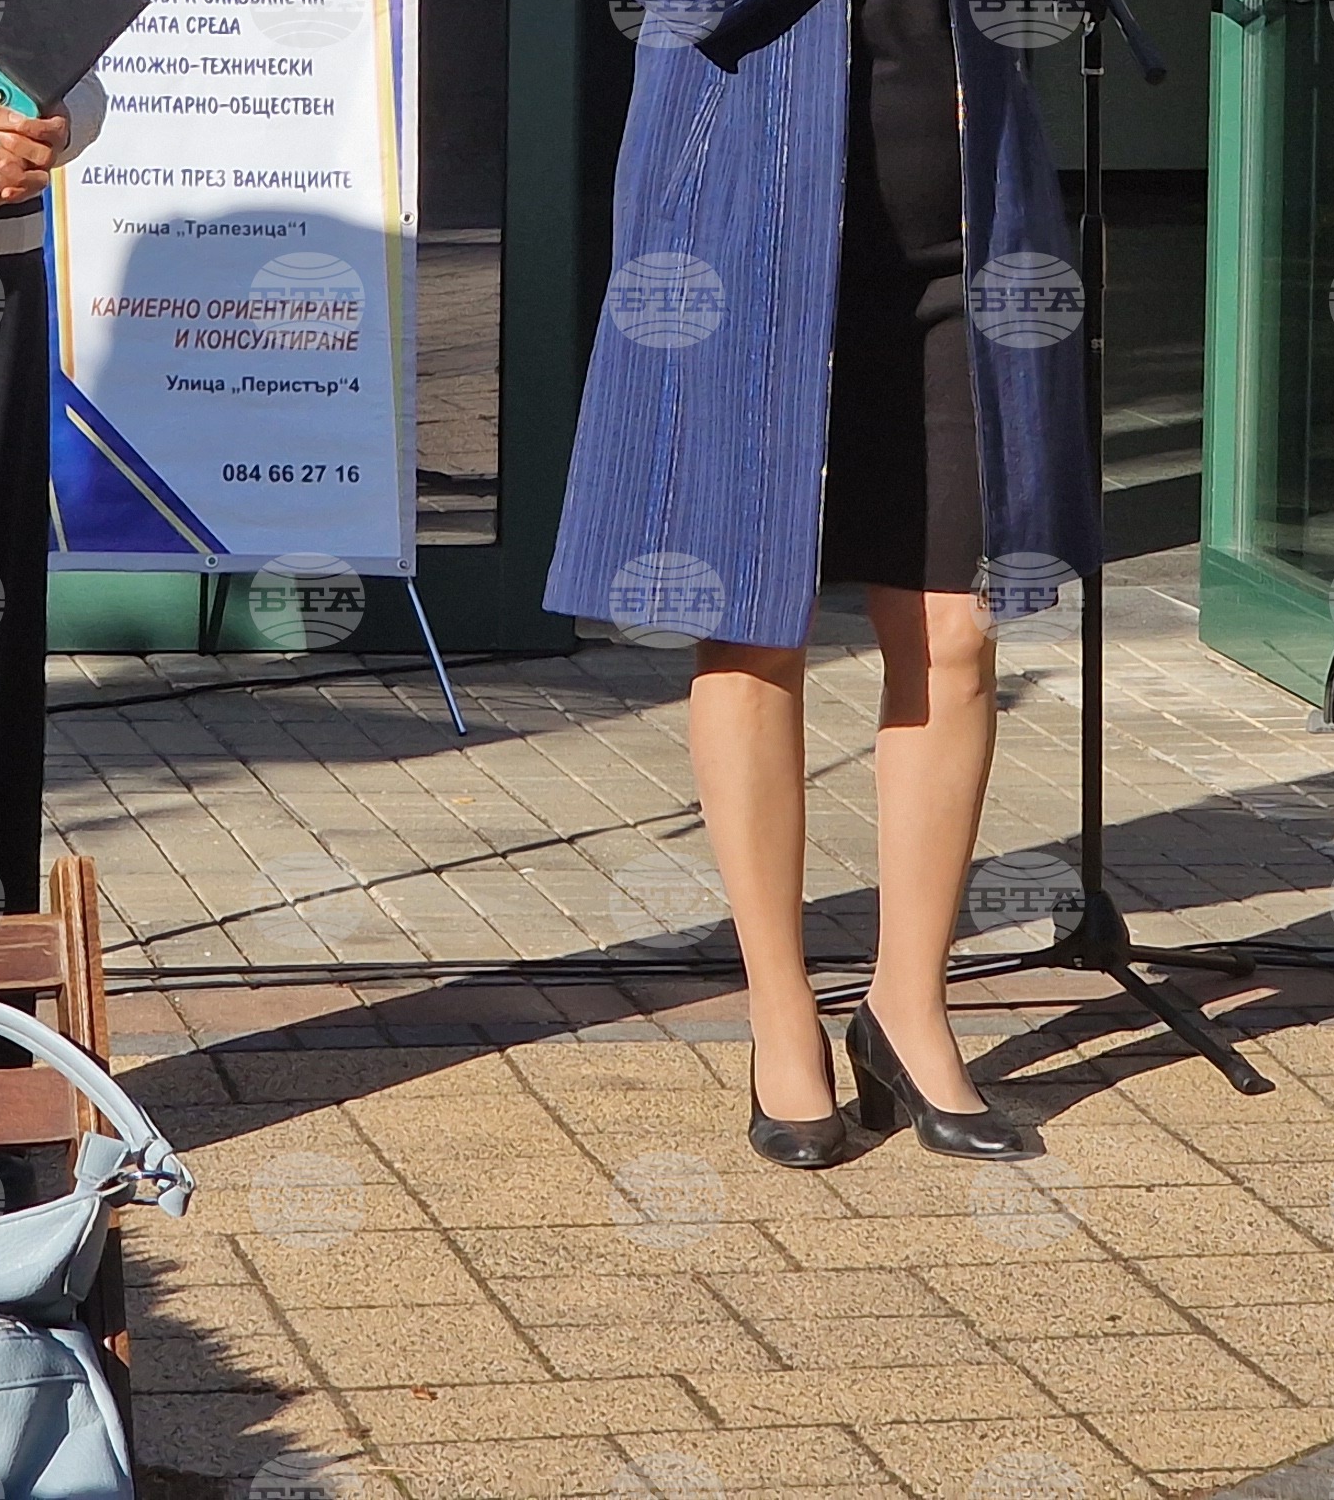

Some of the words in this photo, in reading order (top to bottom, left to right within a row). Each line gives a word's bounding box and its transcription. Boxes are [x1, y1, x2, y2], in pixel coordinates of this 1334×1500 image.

[186, 16, 241, 35] СРЕДА
[107, 95, 335, 119] МАНИТАРНО-ОБЩЕСТВЕН
[81, 166, 174, 188] ДЕЙНОСТИ
[181, 168, 226, 189] ПРЕЗ
[233, 169, 353, 193] ВАКАНЦИИТЕ
[112, 218, 170, 238] Улица
[91, 296, 201, 320] КАРИЕРНО
[207, 299, 359, 321] ОРИЕНТИРАНЕ
[174, 329, 188, 350] И
[193, 329, 359, 352] КОНСУЛТИРАНЕ
[167, 375, 226, 397] Улица
[222, 463, 261, 483] 084
[267, 463, 294, 483] 66
[301, 463, 328, 483] 27
[335, 463, 360, 483] 16
